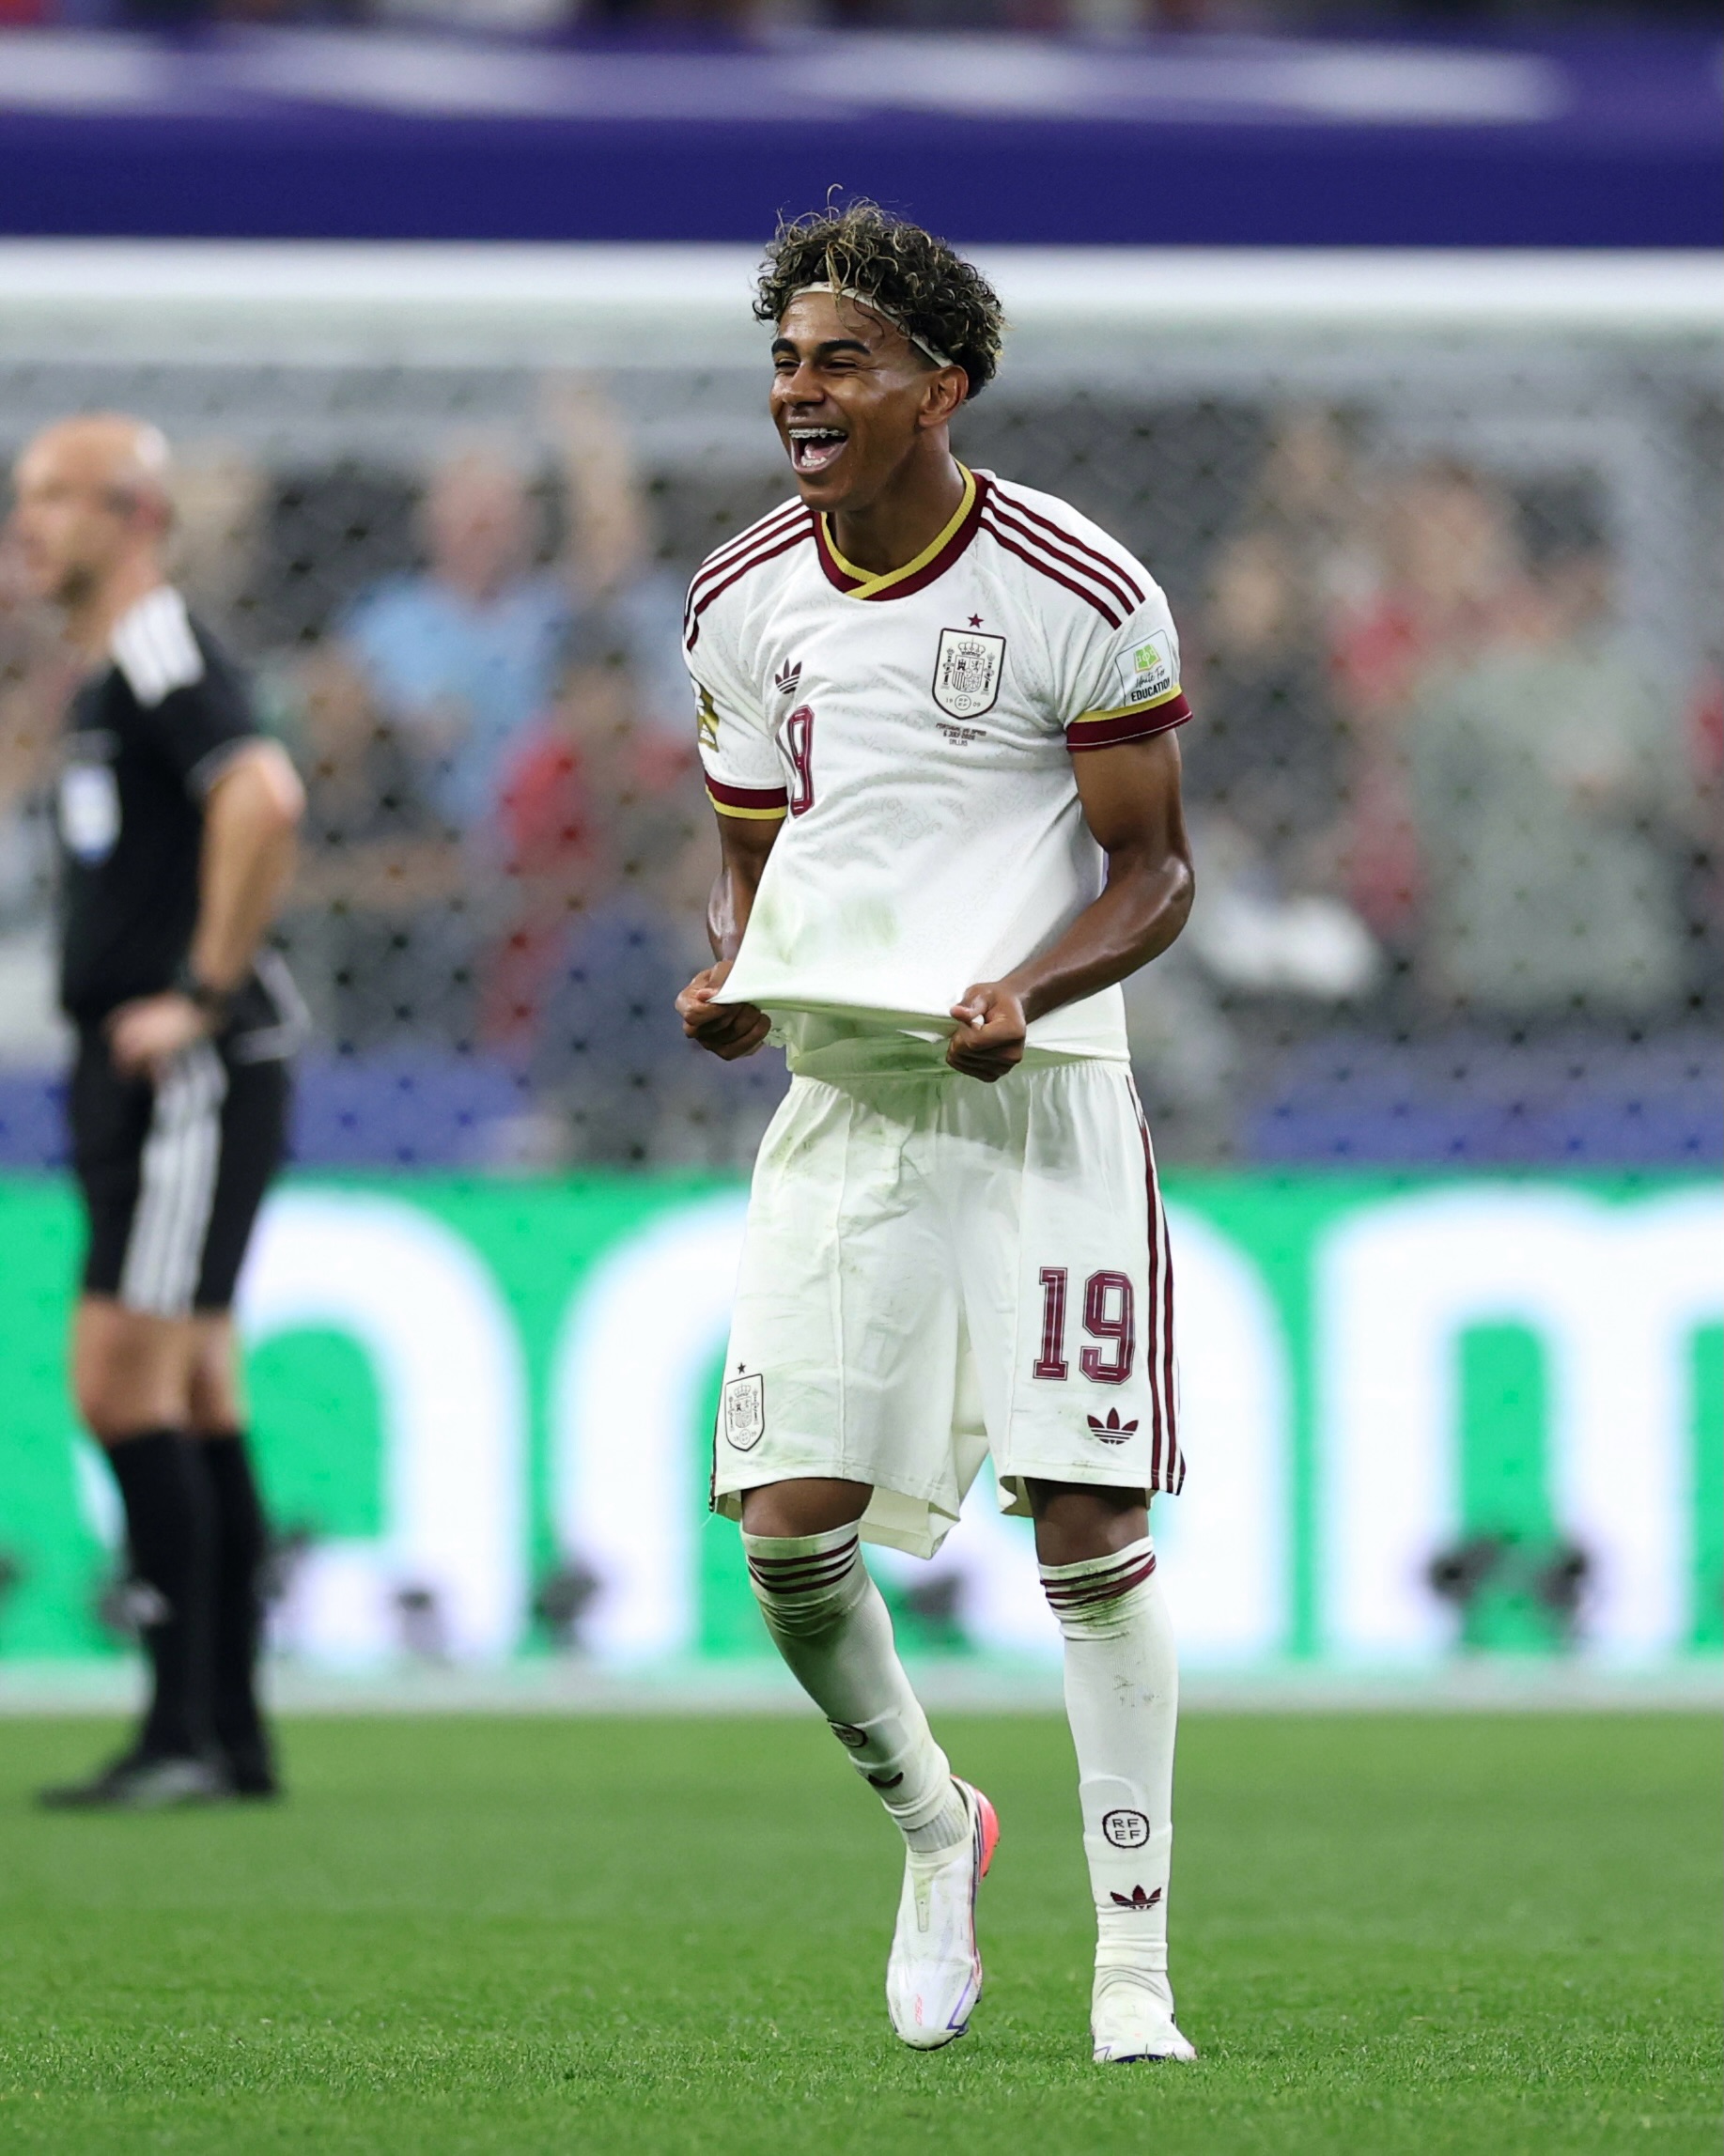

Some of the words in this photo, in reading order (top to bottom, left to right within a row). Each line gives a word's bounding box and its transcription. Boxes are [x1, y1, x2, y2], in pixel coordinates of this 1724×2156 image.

[1130, 676, 1171, 703] EDUCATION
[775, 705, 815, 819] 9
[1033, 1266, 1136, 1385] 19
[1111, 1818, 1140, 1829] RF
[1114, 1829, 1142, 1840] EF
